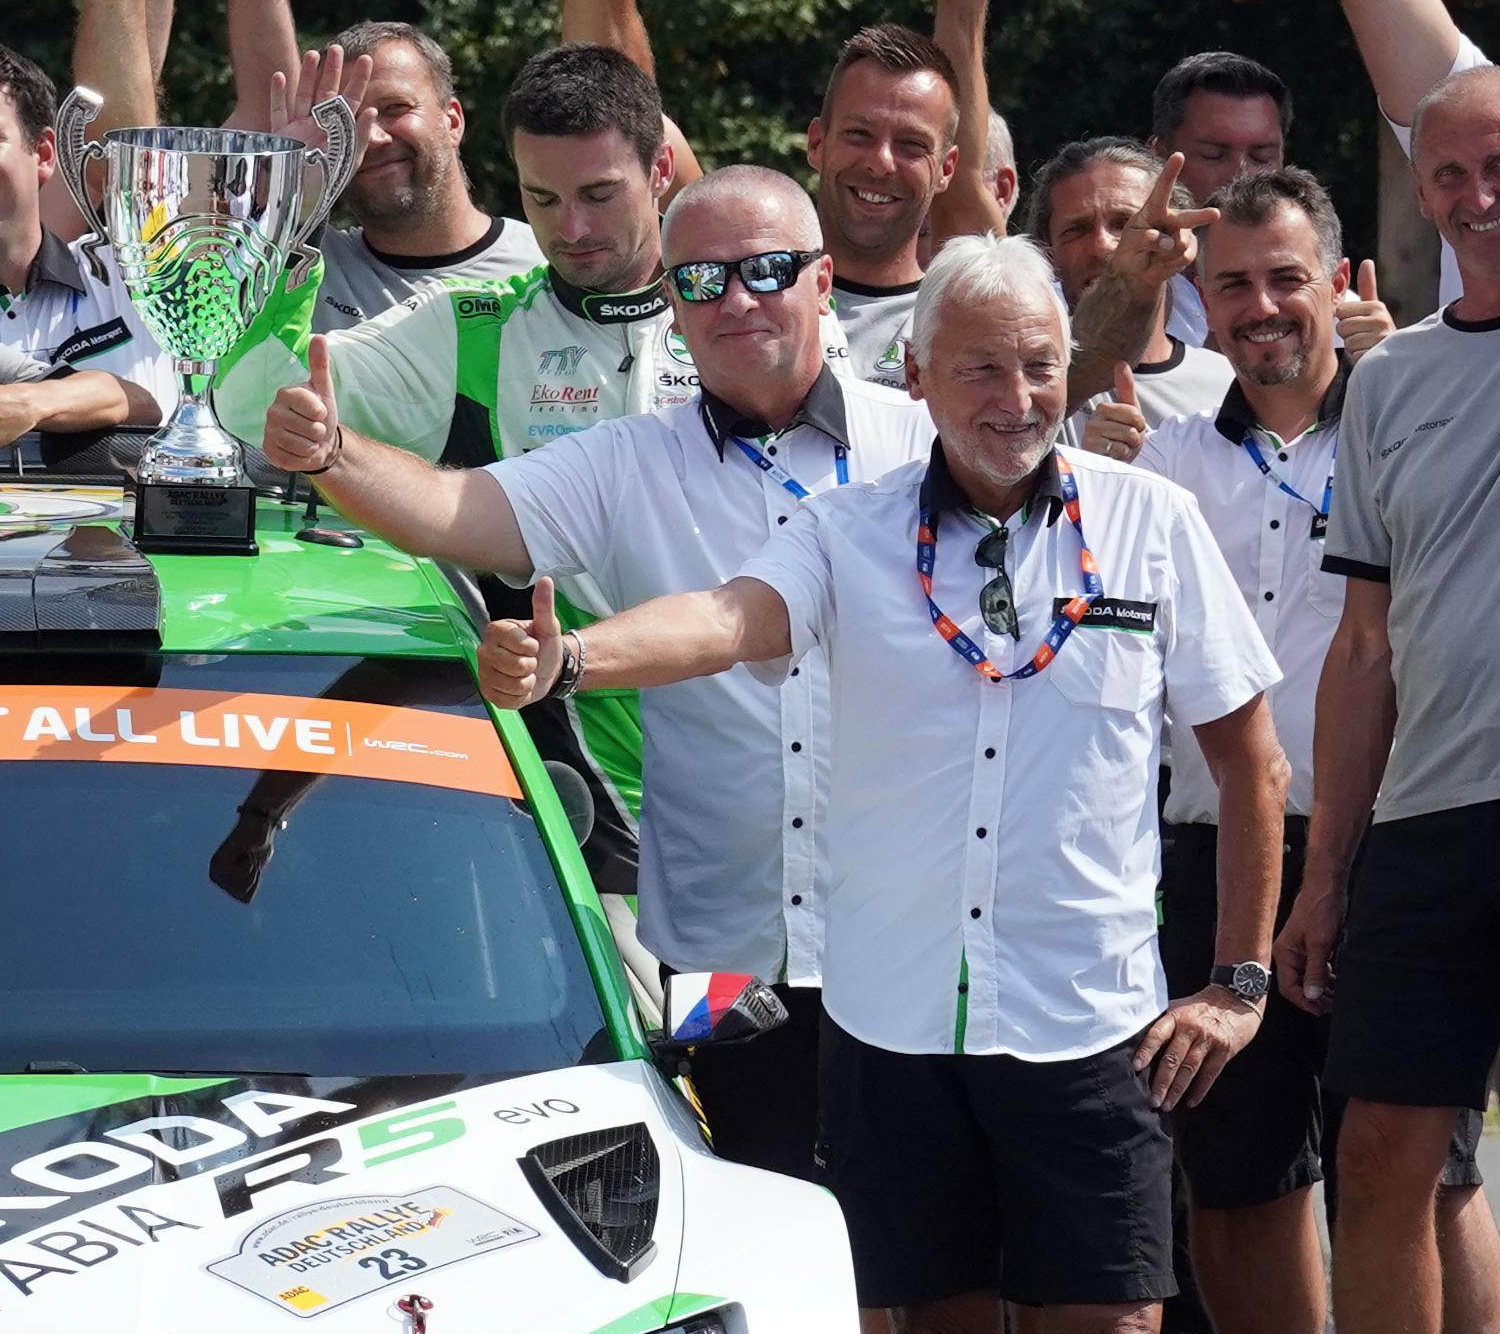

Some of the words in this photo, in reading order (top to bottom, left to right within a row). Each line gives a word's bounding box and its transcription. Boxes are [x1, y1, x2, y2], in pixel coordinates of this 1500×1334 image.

[600, 296, 665, 317] ŠKODA
[22, 704, 135, 746] ALL
[181, 709, 336, 756] LIVE
[491, 1094, 581, 1129] evo
[221, 1099, 467, 1220] R5
[258, 1234, 333, 1268] ADAC
[323, 1200, 431, 1242] RALLYE
[288, 1219, 429, 1274] DEUTSCHLAND
[358, 1247, 429, 1281] 23
[278, 1285, 310, 1302] ADAC
